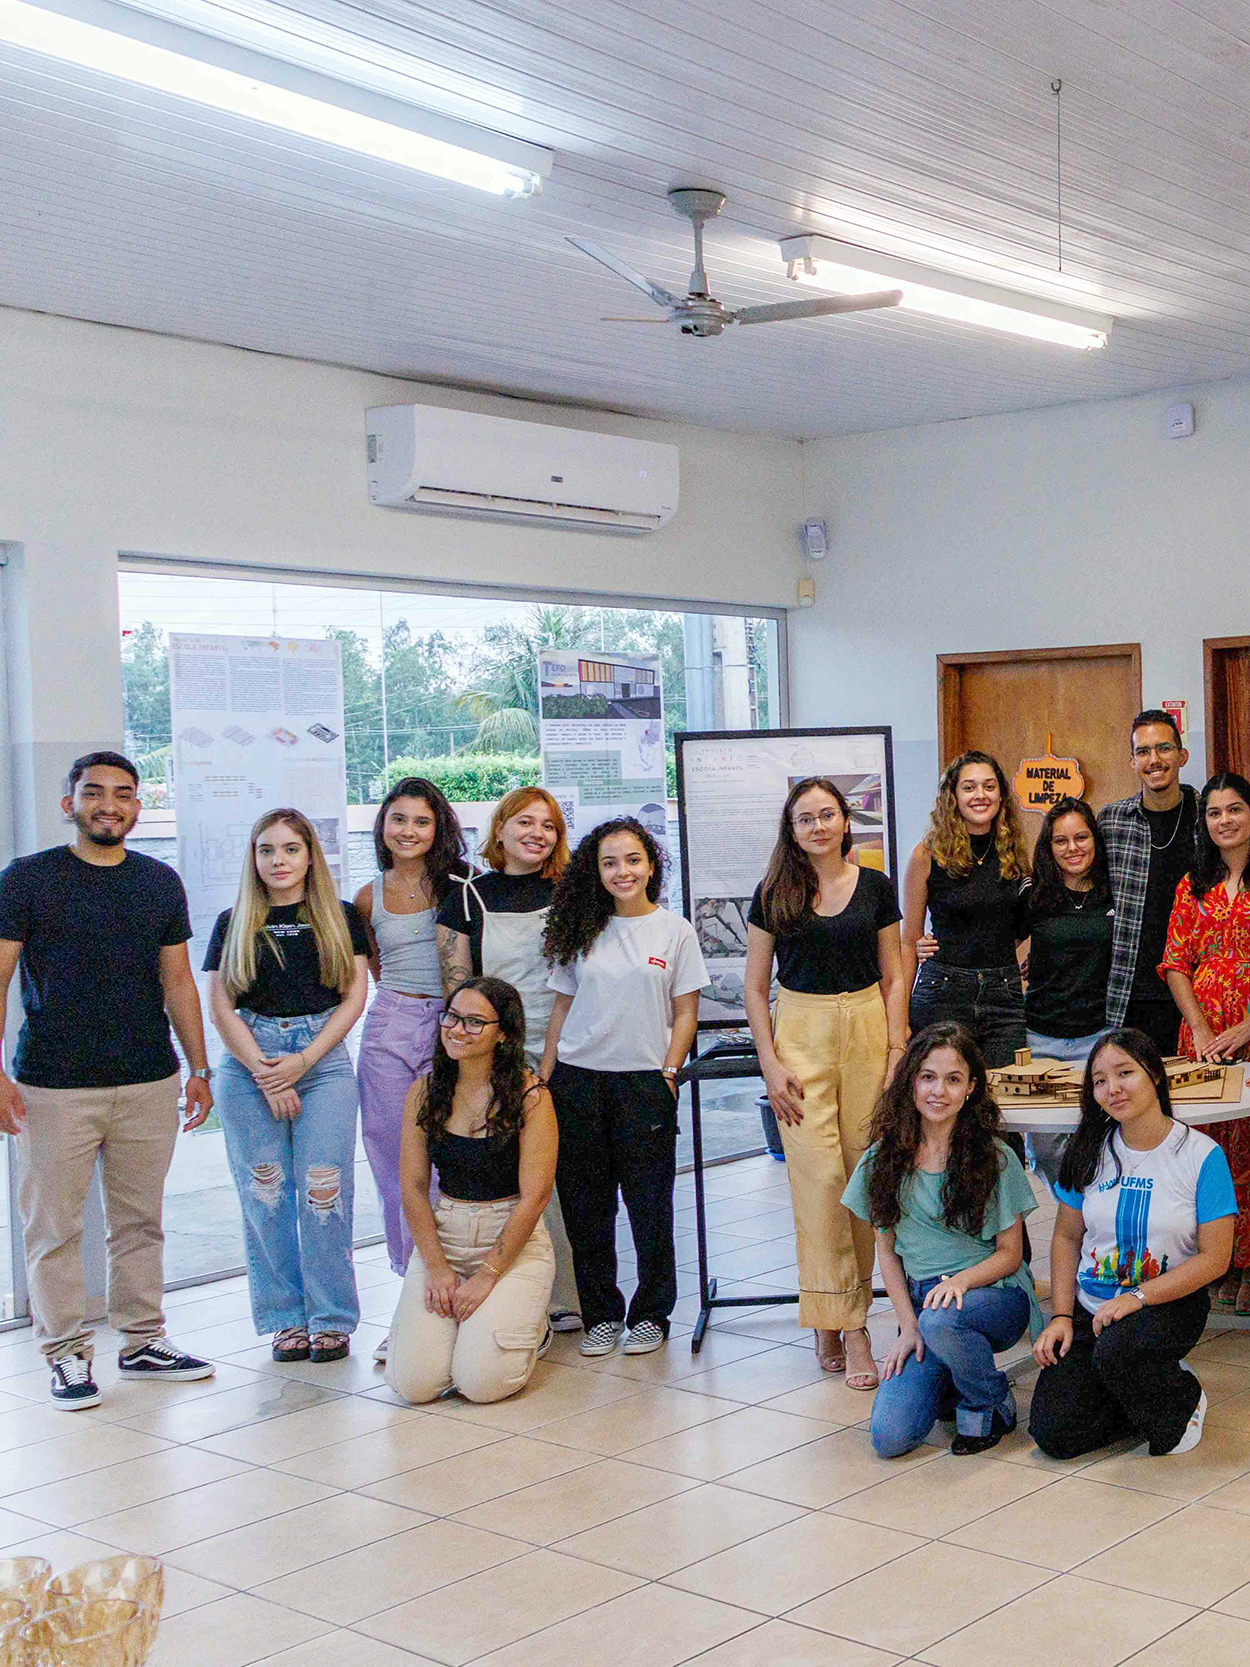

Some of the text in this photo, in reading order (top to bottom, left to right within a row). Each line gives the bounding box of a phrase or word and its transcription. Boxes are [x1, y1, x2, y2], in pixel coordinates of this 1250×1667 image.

[1026, 767, 1071, 780] MATERIAL
[1043, 780, 1055, 792] DE
[1121, 1176, 1154, 1189] UFMS
